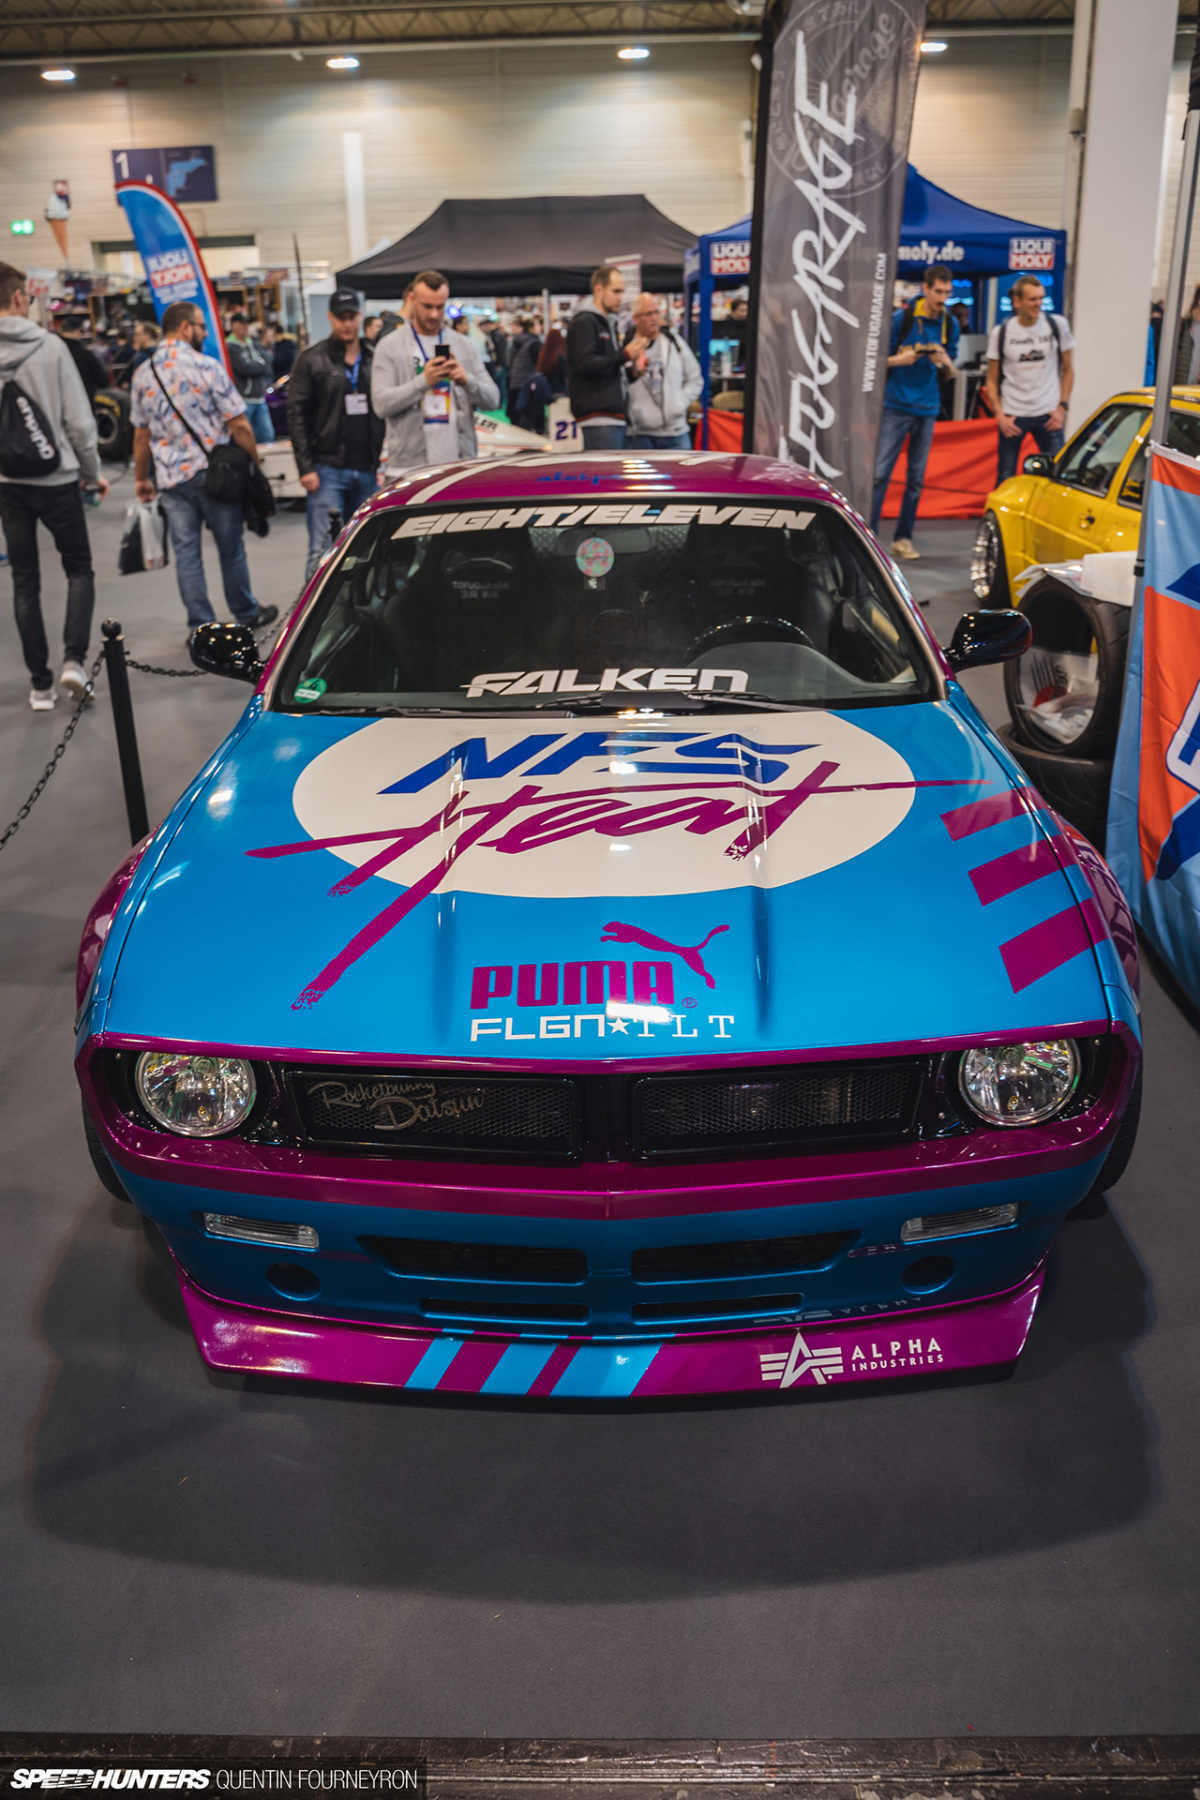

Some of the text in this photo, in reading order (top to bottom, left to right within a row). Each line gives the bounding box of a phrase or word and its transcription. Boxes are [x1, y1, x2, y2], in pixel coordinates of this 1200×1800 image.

[1012, 239, 1053, 254] LIQUI
[1011, 254, 1053, 269] MOLY
[555, 420, 577, 441] 21
[390, 504, 817, 540] EIGHT/ELEVEN
[460, 668, 749, 698] FALKEN
[377, 732, 822, 794] NFS
[470, 961, 675, 1010] PUMA
[366, 1094, 485, 1131] Datsun
[851, 1337, 942, 1360] ALPHA
[851, 1353, 944, 1372] INDUSTRIES
